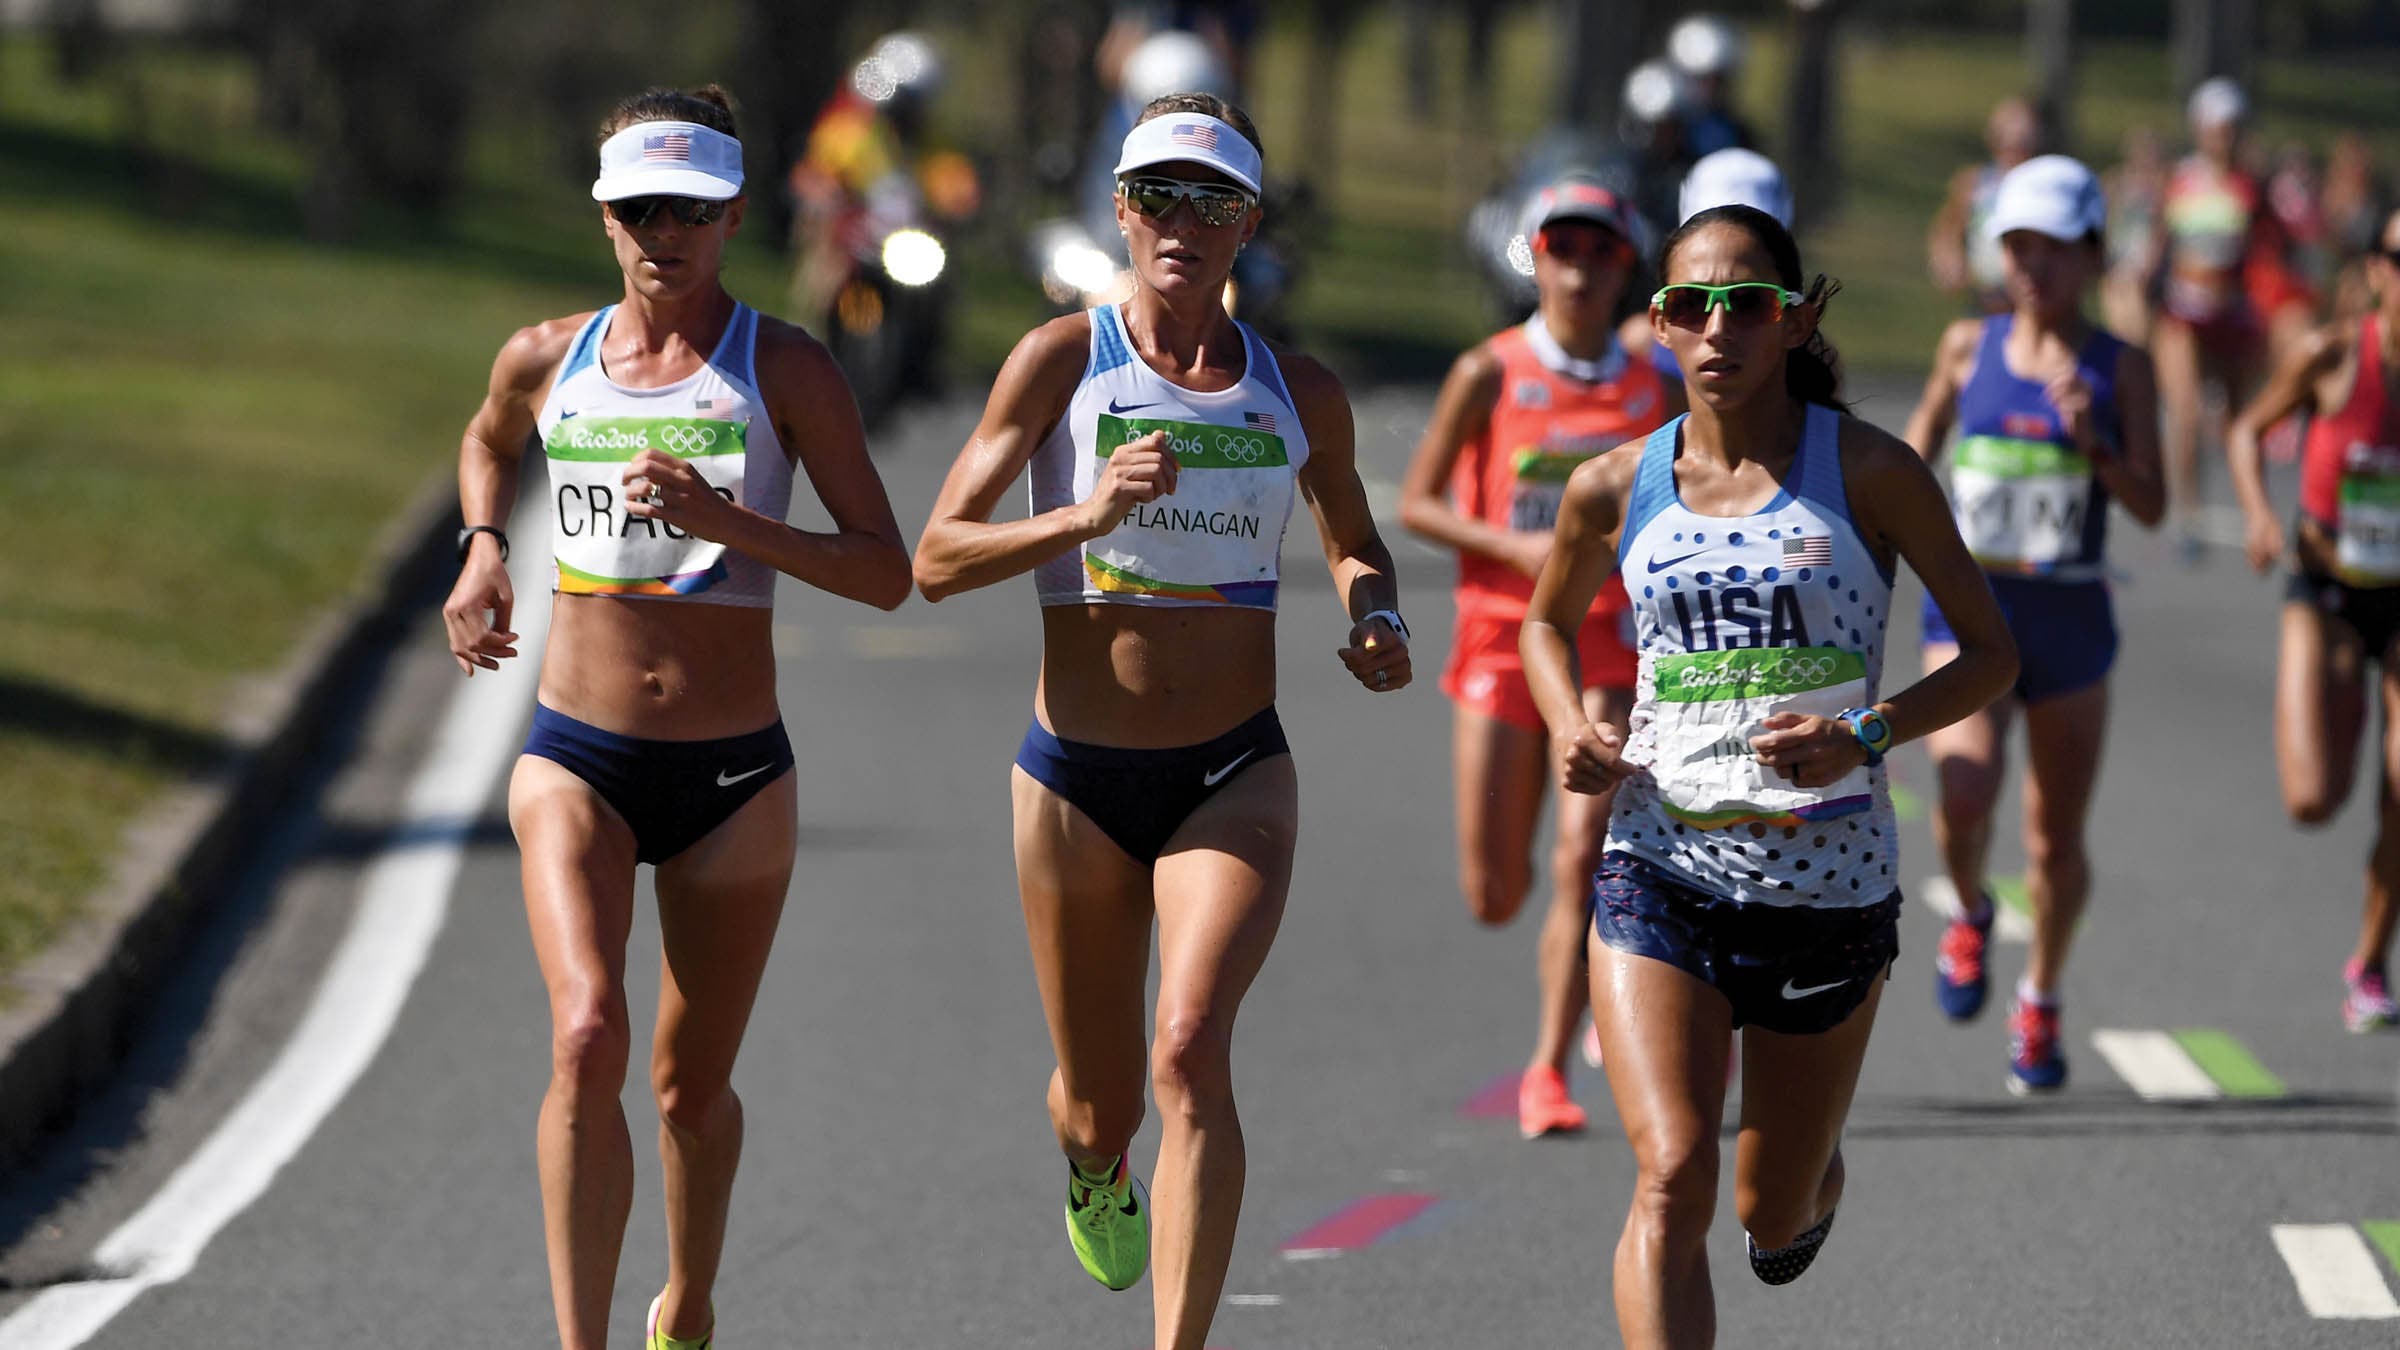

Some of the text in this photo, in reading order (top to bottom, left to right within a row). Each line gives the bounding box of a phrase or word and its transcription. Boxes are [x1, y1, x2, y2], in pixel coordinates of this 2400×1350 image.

[571, 427, 648, 448] Rio2016
[1123, 504, 1260, 539] FLANAGAN
[1671, 585, 1811, 651] USA
